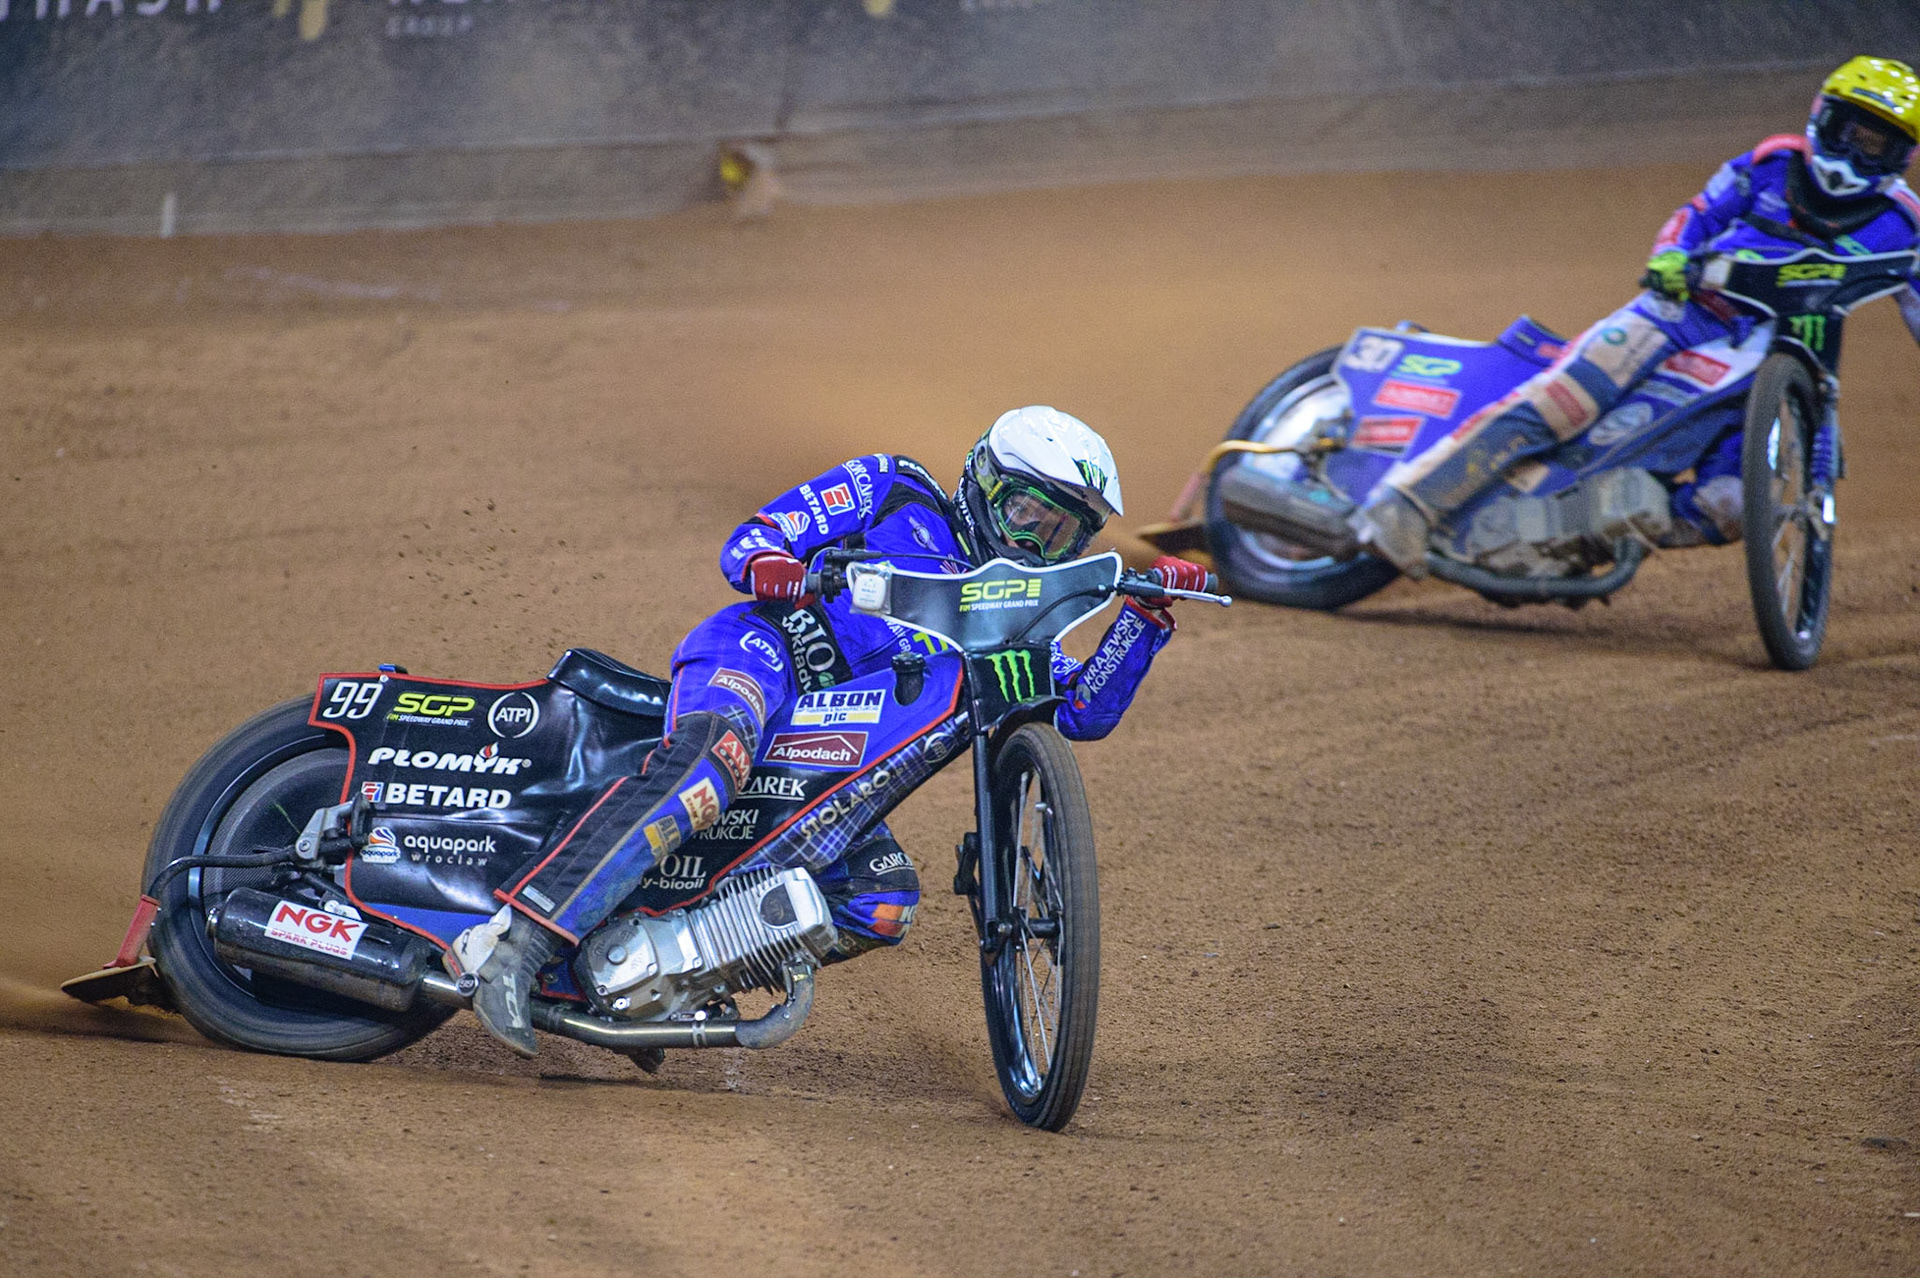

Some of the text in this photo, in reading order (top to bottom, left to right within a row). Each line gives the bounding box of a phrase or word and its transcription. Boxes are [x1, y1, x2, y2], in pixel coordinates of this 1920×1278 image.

[799, 484, 830, 535] BETARD
[960, 580, 1027, 603] SGP
[971, 602, 1002, 611] SPEEDWAY
[1003, 600, 1024, 609] GRAND
[1024, 599, 1039, 607] PRIX
[747, 637, 780, 664] ATPI
[788, 609, 835, 672] BIO
[1083, 609, 1137, 685] KRAJEWSKI
[1089, 618, 1147, 695] KONSTRUKCJE
[322, 682, 383, 719] 99
[393, 692, 476, 717] SGP
[798, 691, 882, 708] ALBON
[431, 717, 454, 725] GRAND
[495, 706, 532, 723] ATPI
[823, 713, 847, 724] plc
[368, 747, 522, 775] PŁOMYK
[772, 747, 851, 761] Alpodach
[385, 783, 512, 809] BETARD
[404, 835, 497, 855] aquapark
[660, 853, 707, 878] OIL
[275, 904, 359, 943] NGK
[271, 928, 348, 956] SPARK PLUGS
